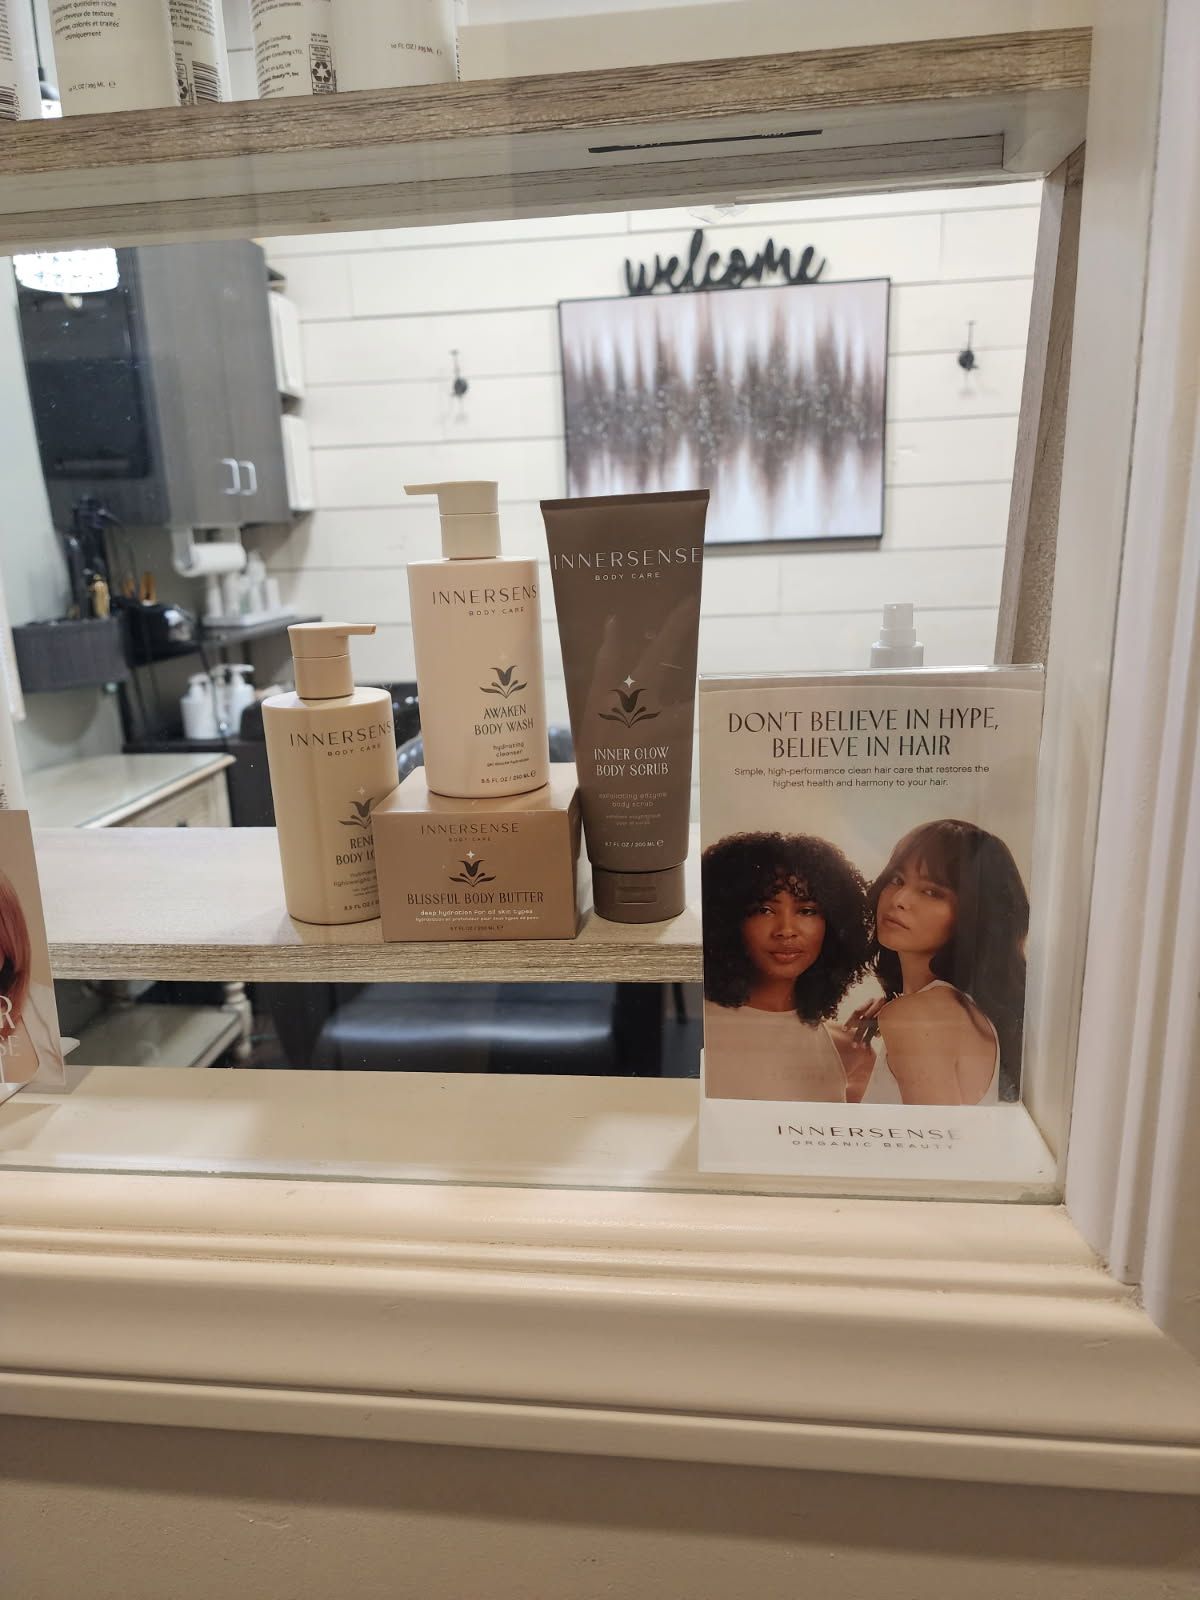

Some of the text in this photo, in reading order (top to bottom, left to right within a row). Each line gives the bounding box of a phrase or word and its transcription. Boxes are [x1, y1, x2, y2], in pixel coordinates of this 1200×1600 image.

[625, 228, 826, 296] welcome
[553, 547, 702, 570] INNERSENSE
[502, 606, 524, 614] CARE
[483, 703, 527, 720] AWAKEN
[474, 717, 534, 736] BODY WASH
[728, 707, 1000, 733] DON'T BELIEVE IN HYPE,
[327, 748, 354, 757] BODY
[594, 746, 669, 761] INNER GLOW
[773, 735, 951, 758] BELIEVE IN HAIR
[596, 762, 669, 777] BODY SCRUB
[734, 765, 990, 777] Simple, high-performance clean hair care that restores the
[773, 780, 805, 789] highest
[806, 779, 834, 787] health
[835, 779, 853, 787] and
[855, 779, 894, 788] harmony
[907, 779, 927, 787] your
[929, 778, 948, 786] hair.
[420, 823, 520, 835] INNERSENSE
[335, 852, 363, 865] BODY
[407, 891, 544, 905] BLISSFUL BODY BUTTER
[439, 909, 472, 917] hydration
[778, 1124, 963, 1140] INNERSENSE
[792, 1140, 872, 1148] ORGANIC
